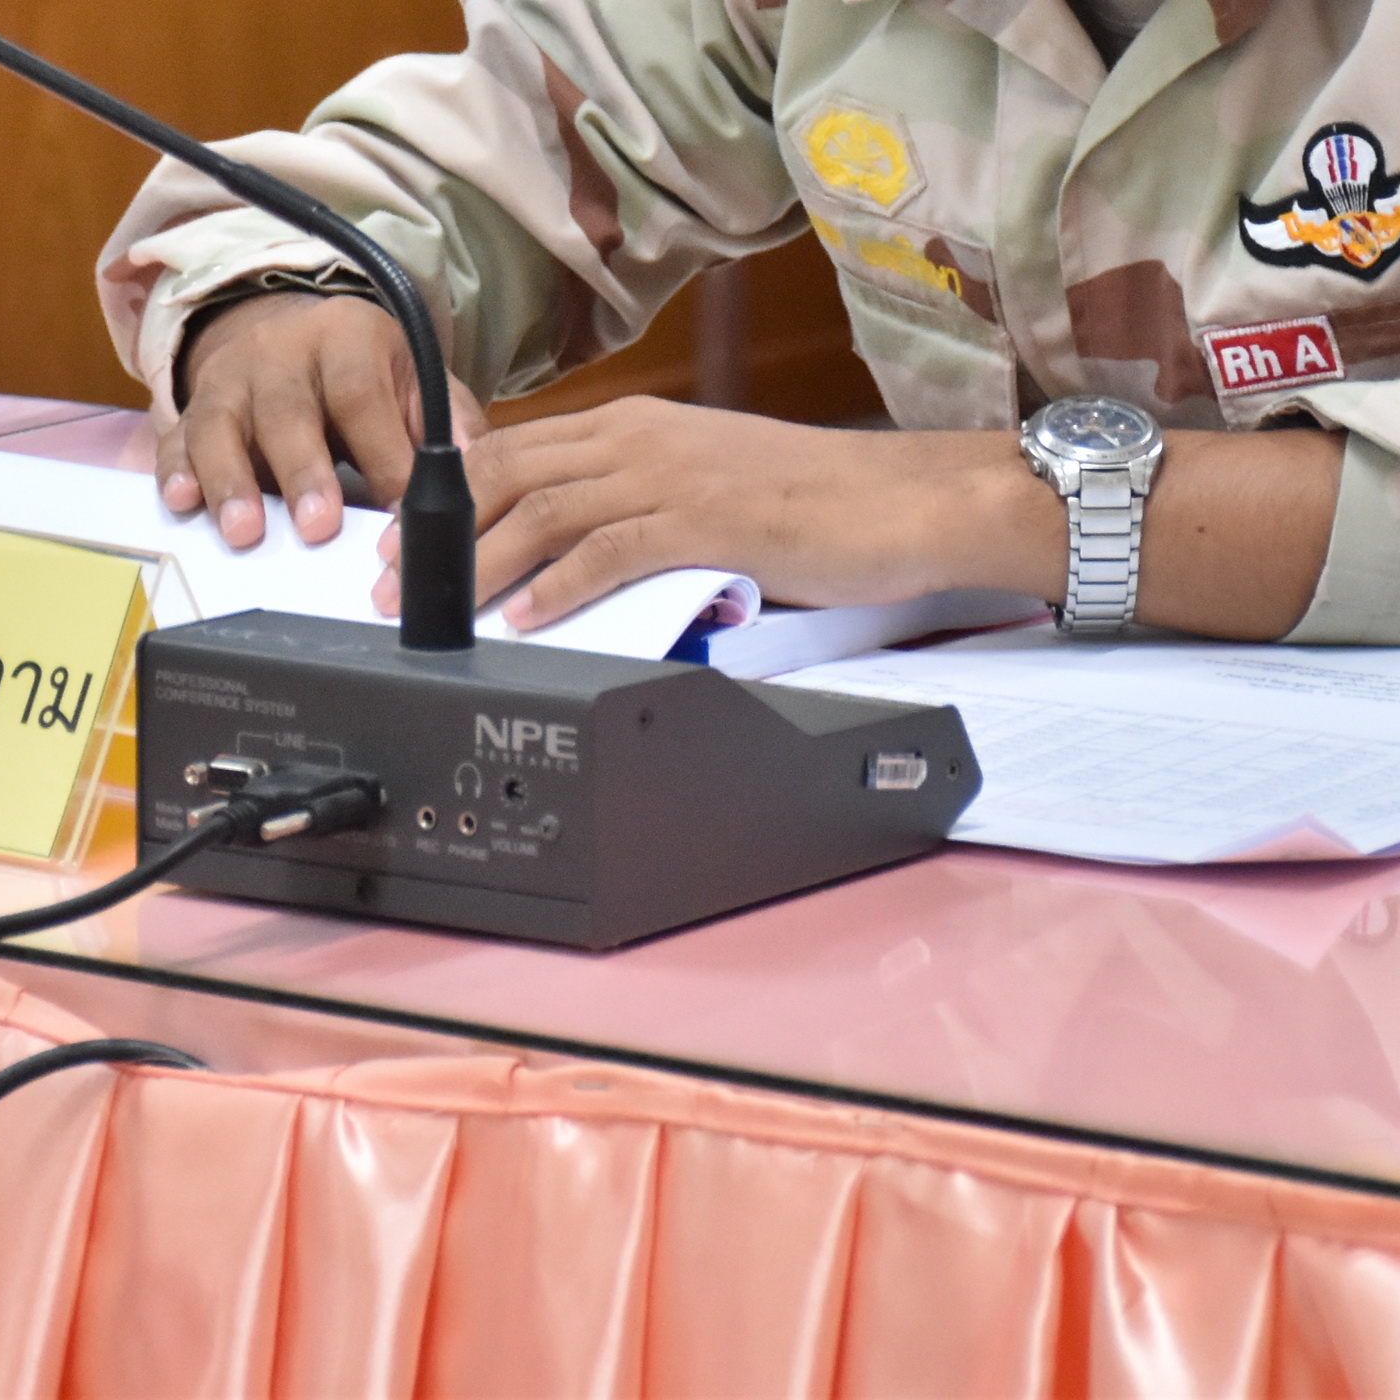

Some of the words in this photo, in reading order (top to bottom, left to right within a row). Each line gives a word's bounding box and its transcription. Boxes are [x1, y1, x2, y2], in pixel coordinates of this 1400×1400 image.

[1220, 343, 1283, 385] Rh
[1296, 334, 1329, 373] A
[155, 685, 240, 711] CONFERENCE
[244, 699, 297, 718] SYSTEM
[274, 731, 307, 751] LINE
[475, 712, 579, 761] NPE
